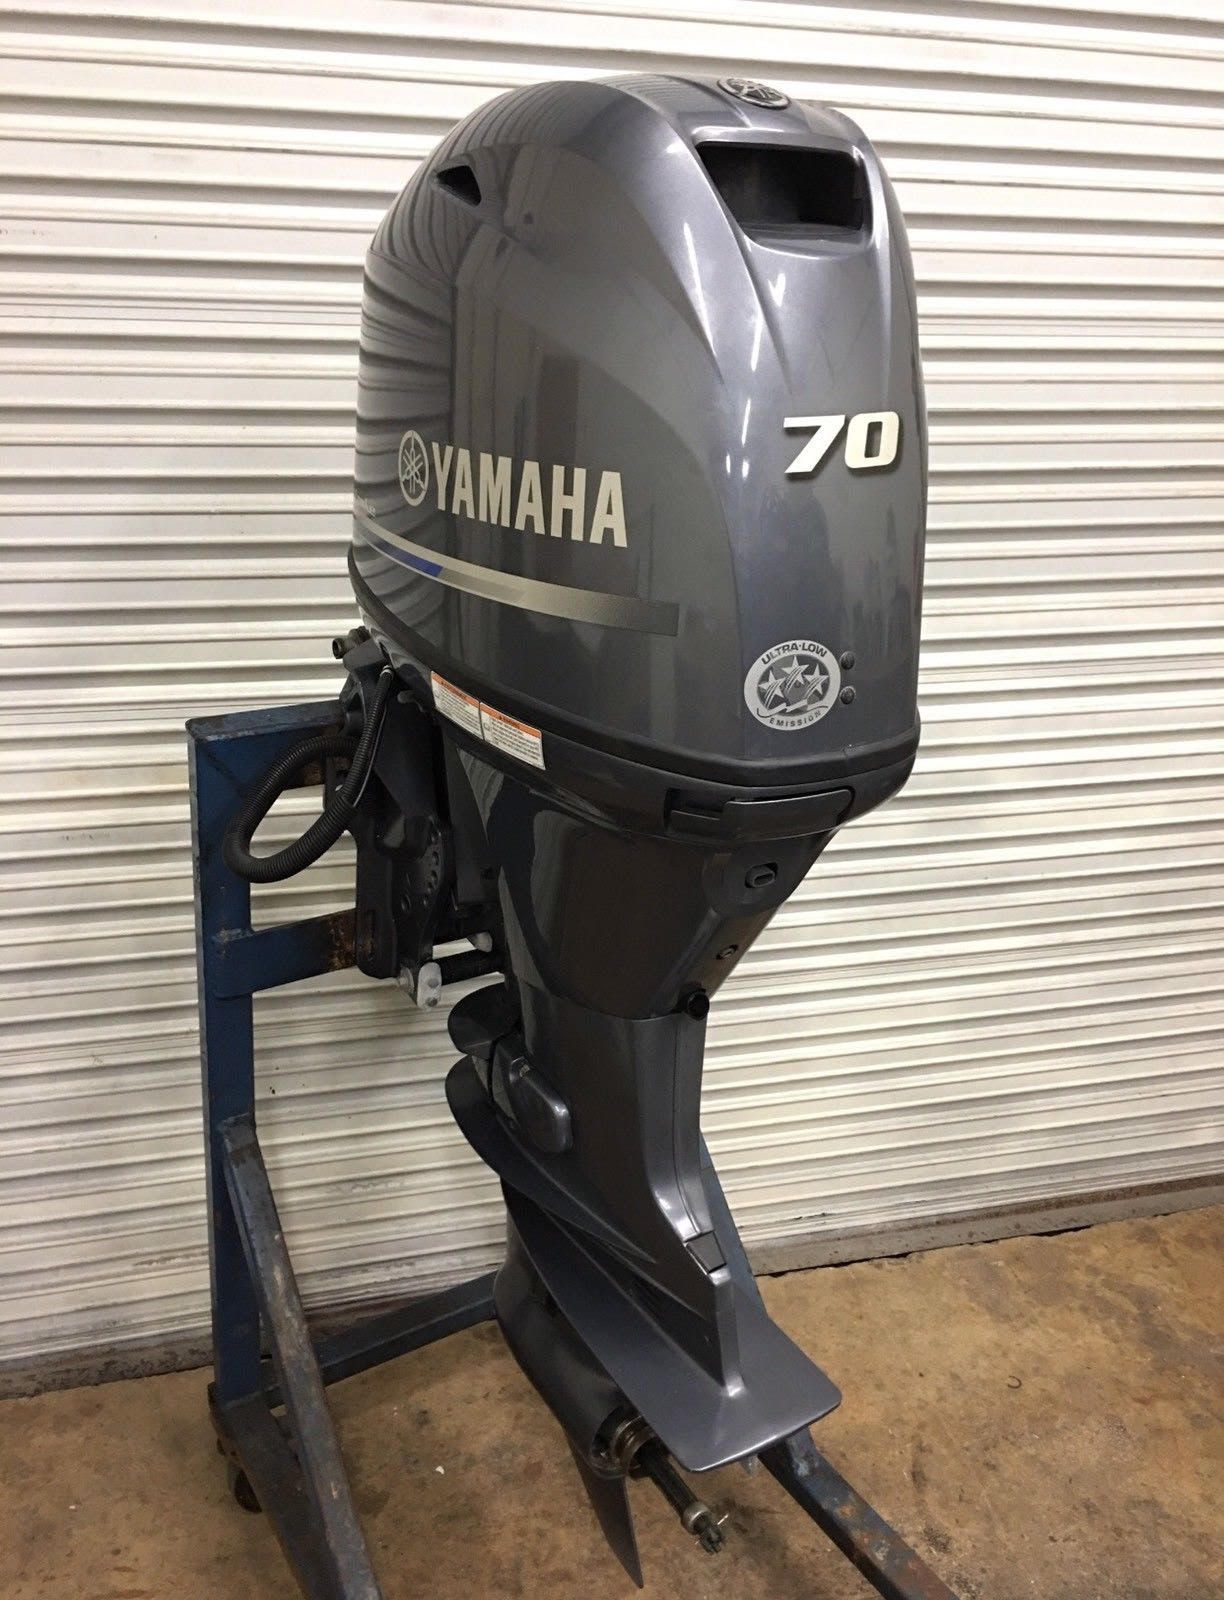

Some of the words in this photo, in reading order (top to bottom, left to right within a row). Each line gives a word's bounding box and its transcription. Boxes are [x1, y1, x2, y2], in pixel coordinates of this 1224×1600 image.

[783, 411, 900, 474] 70
[432, 441, 627, 548] YAMAHA
[770, 711, 821, 727] EMISSION
